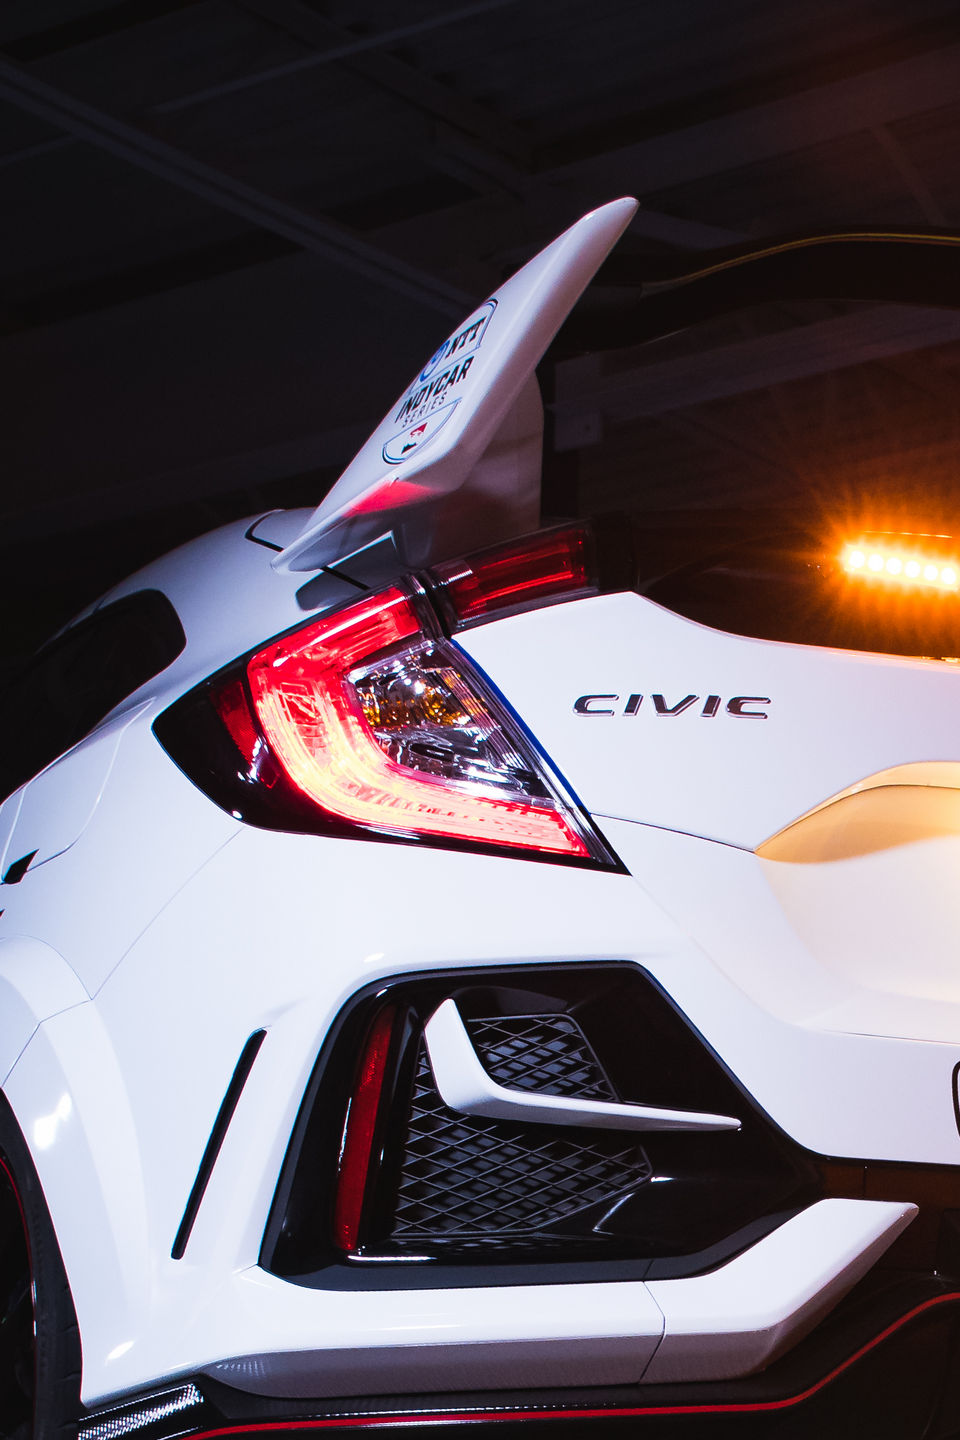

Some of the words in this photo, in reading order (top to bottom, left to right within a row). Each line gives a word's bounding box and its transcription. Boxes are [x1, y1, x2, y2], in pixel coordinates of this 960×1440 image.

[445, 316, 487, 360] NTT
[395, 356, 474, 423] INDYCAR
[402, 391, 448, 428] SERIES
[573, 693, 771, 719] CIVIC
